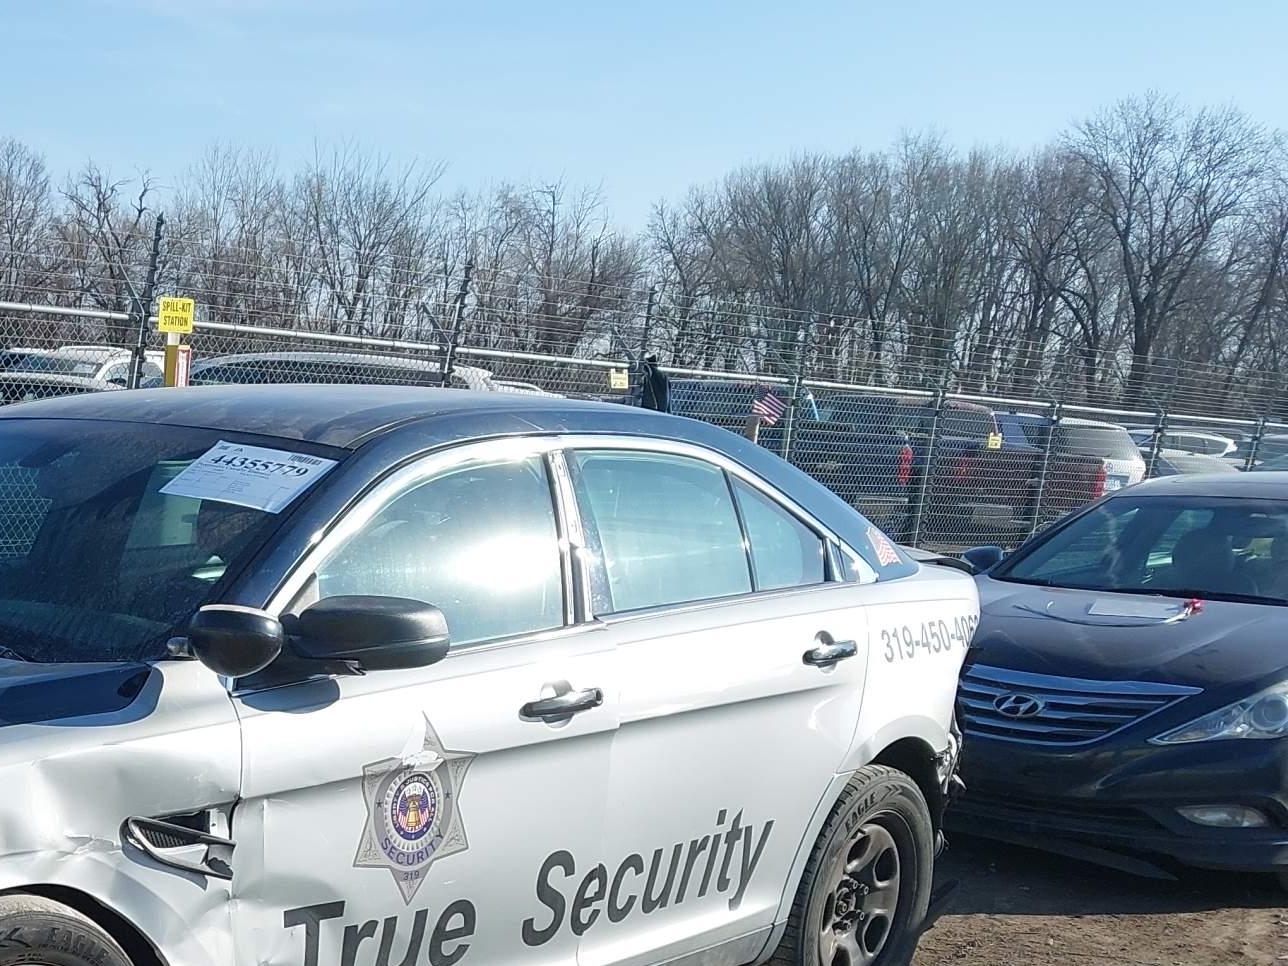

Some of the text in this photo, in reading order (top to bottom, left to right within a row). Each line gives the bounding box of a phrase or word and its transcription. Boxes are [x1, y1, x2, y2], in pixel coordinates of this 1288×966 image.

[162, 300, 192, 313] SPILL-KIT
[163, 315, 189, 327] STATION
[210, 454, 309, 477] 44355779
[380, 827, 444, 866] SECURITY
[403, 870, 420, 881] 319
[521, 808, 775, 947] Security
